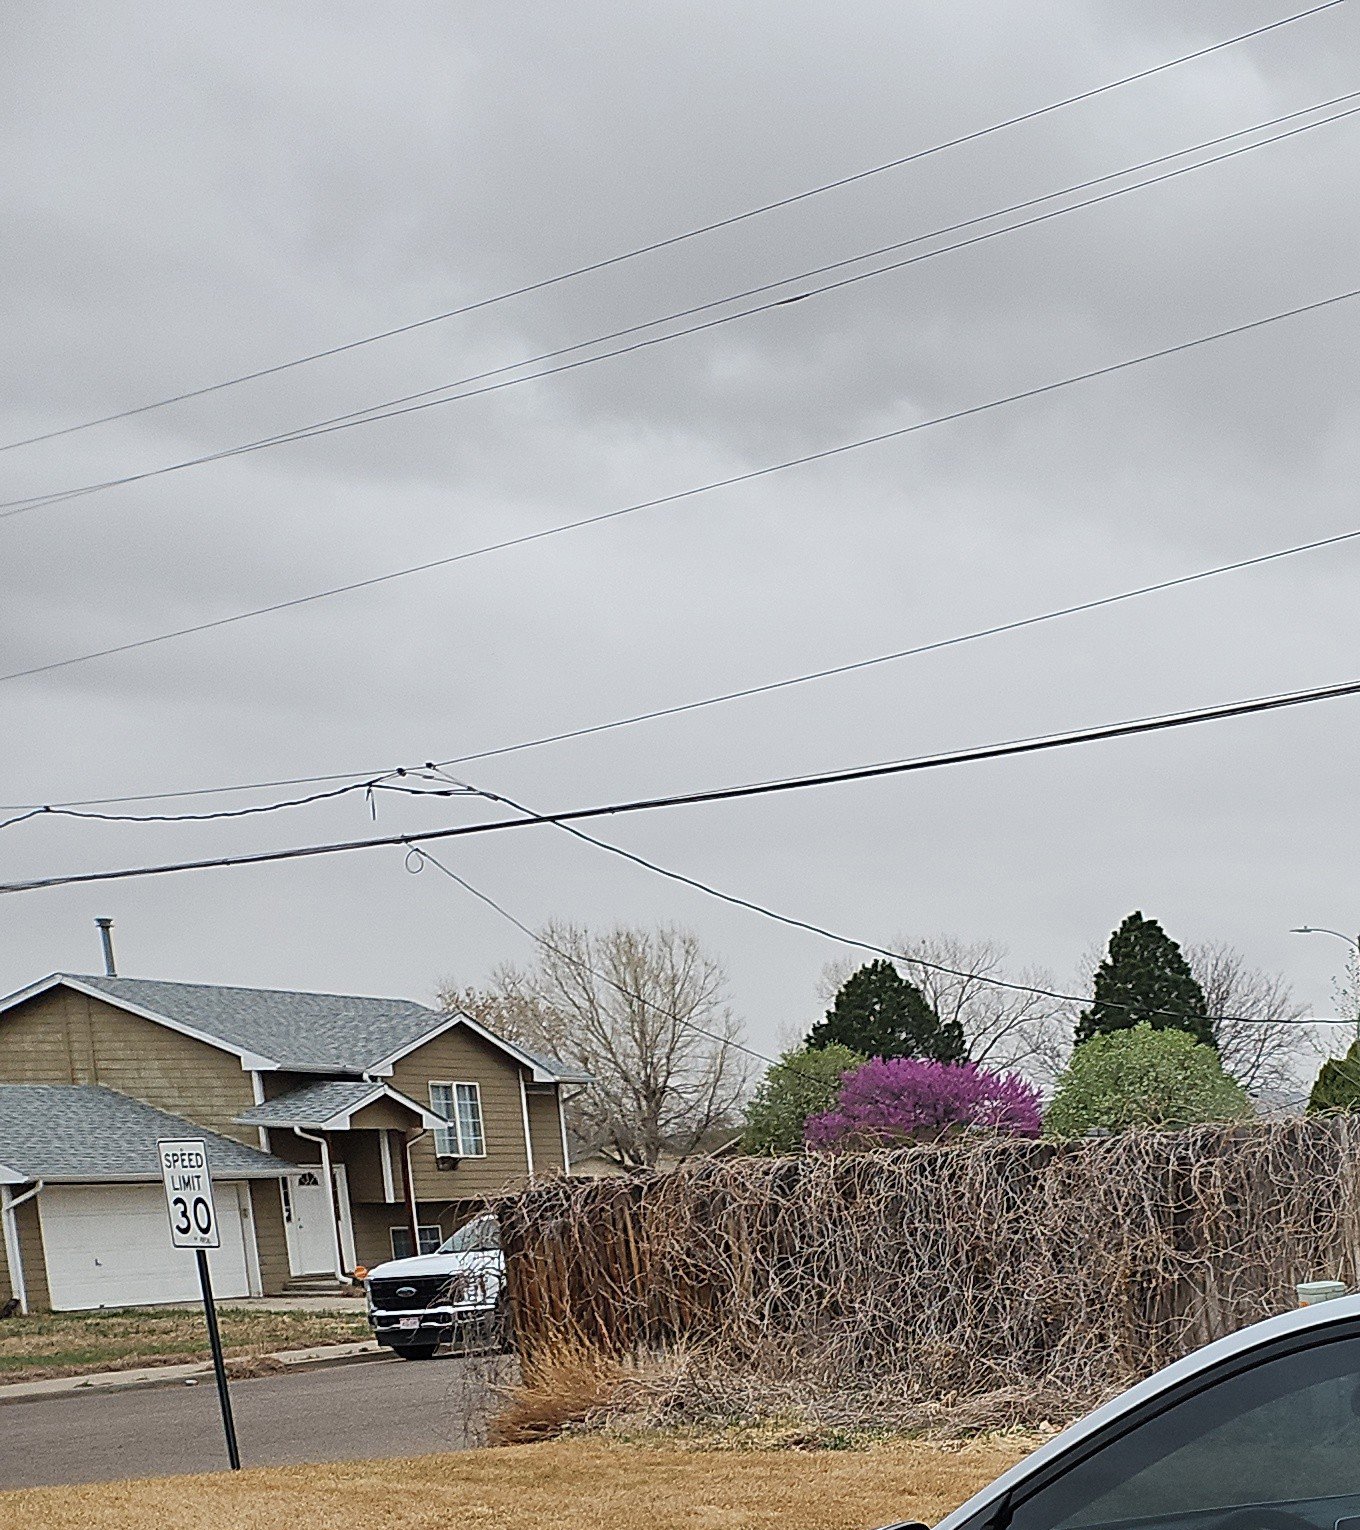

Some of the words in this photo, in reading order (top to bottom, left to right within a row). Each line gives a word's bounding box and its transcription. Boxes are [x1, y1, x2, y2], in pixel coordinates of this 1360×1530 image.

[163, 1152, 204, 1169] SPEED
[170, 1174, 202, 1191] LIMIT
[172, 1196, 212, 1235] 30
